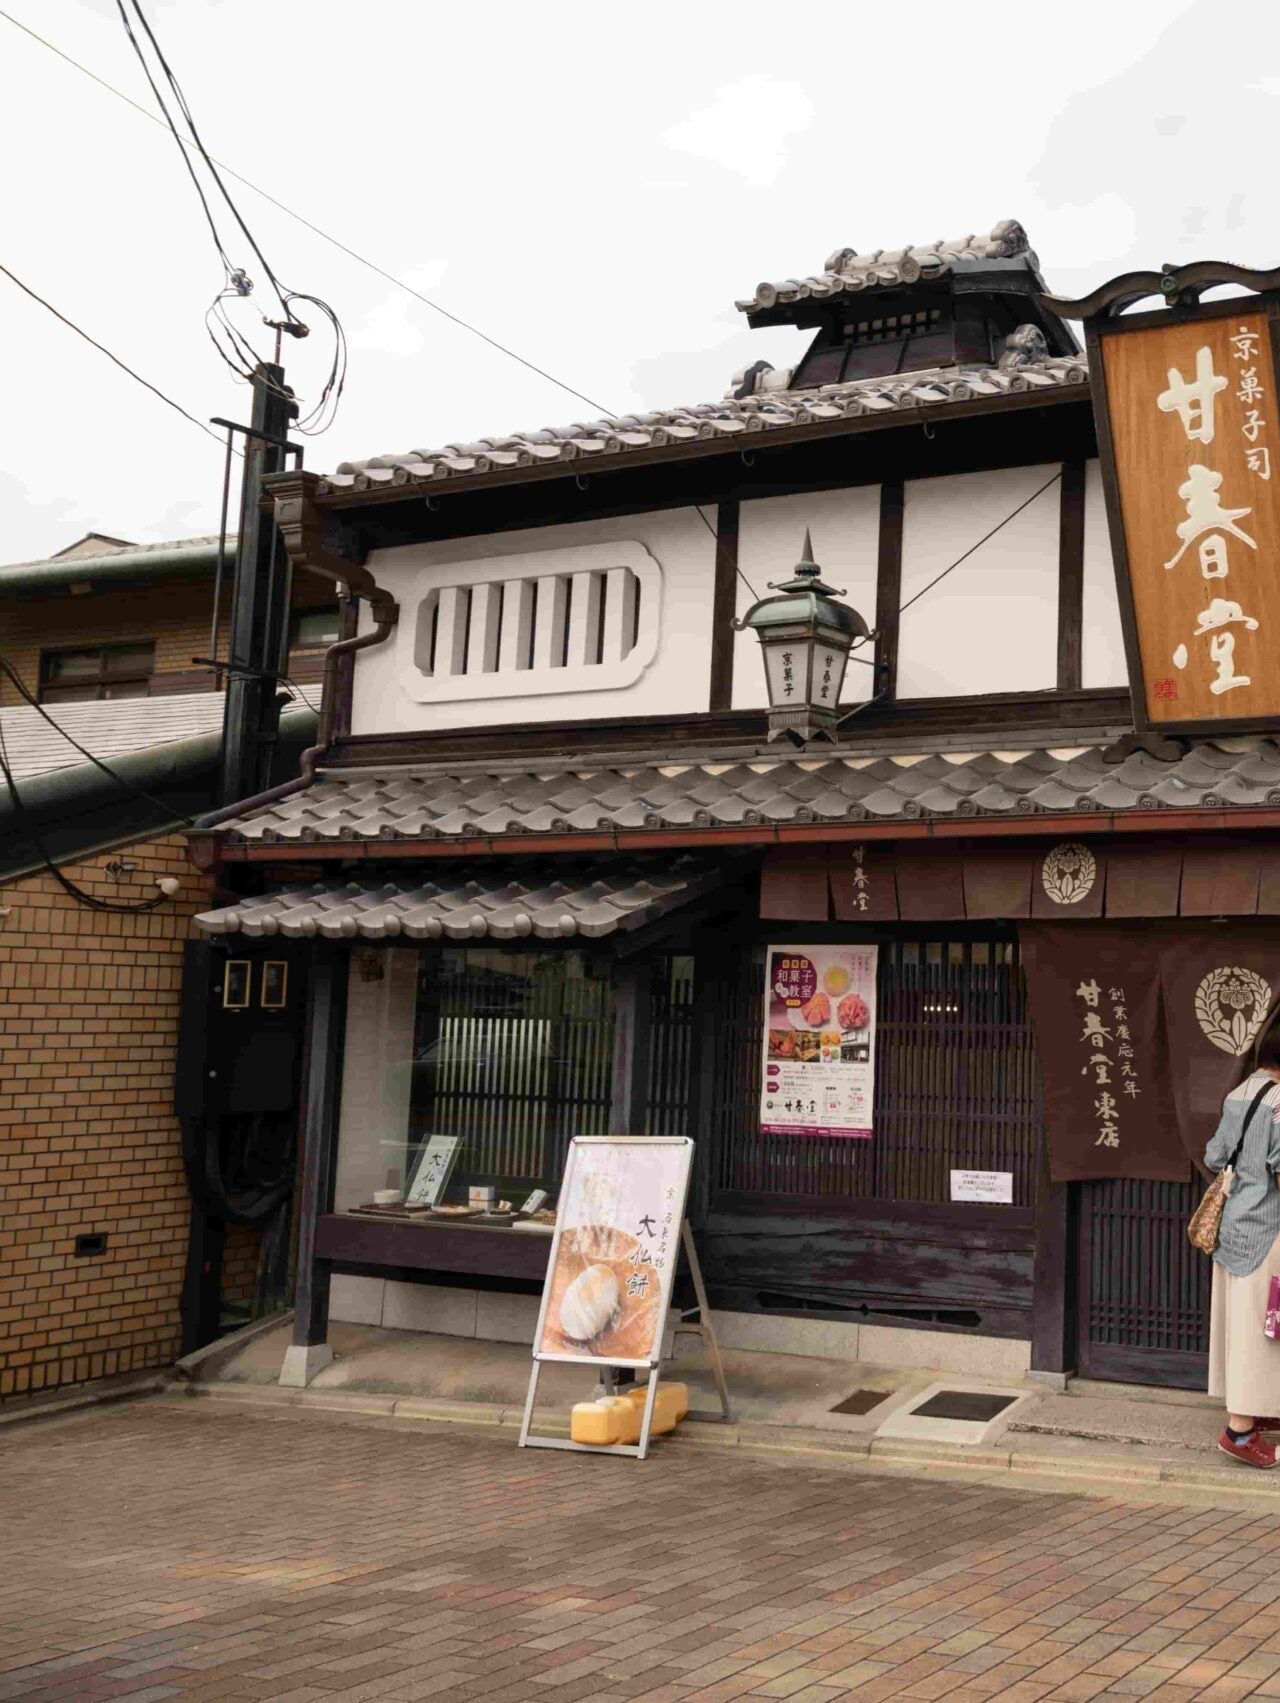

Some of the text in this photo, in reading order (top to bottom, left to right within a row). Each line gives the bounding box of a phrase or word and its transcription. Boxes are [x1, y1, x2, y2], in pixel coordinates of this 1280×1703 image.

[1229, 326, 1271, 480] 京菓子司
[1156, 346, 1260, 695] 甘春堂
[850, 845, 871, 911] 甘春堂
[776, 969, 813, 983] 和菓子
[1076, 978, 1120, 1148] 甘春堂東店
[1108, 987, 1141, 1099] 創業慶応元年
[626, 1214, 656, 1296] 大仏餅
